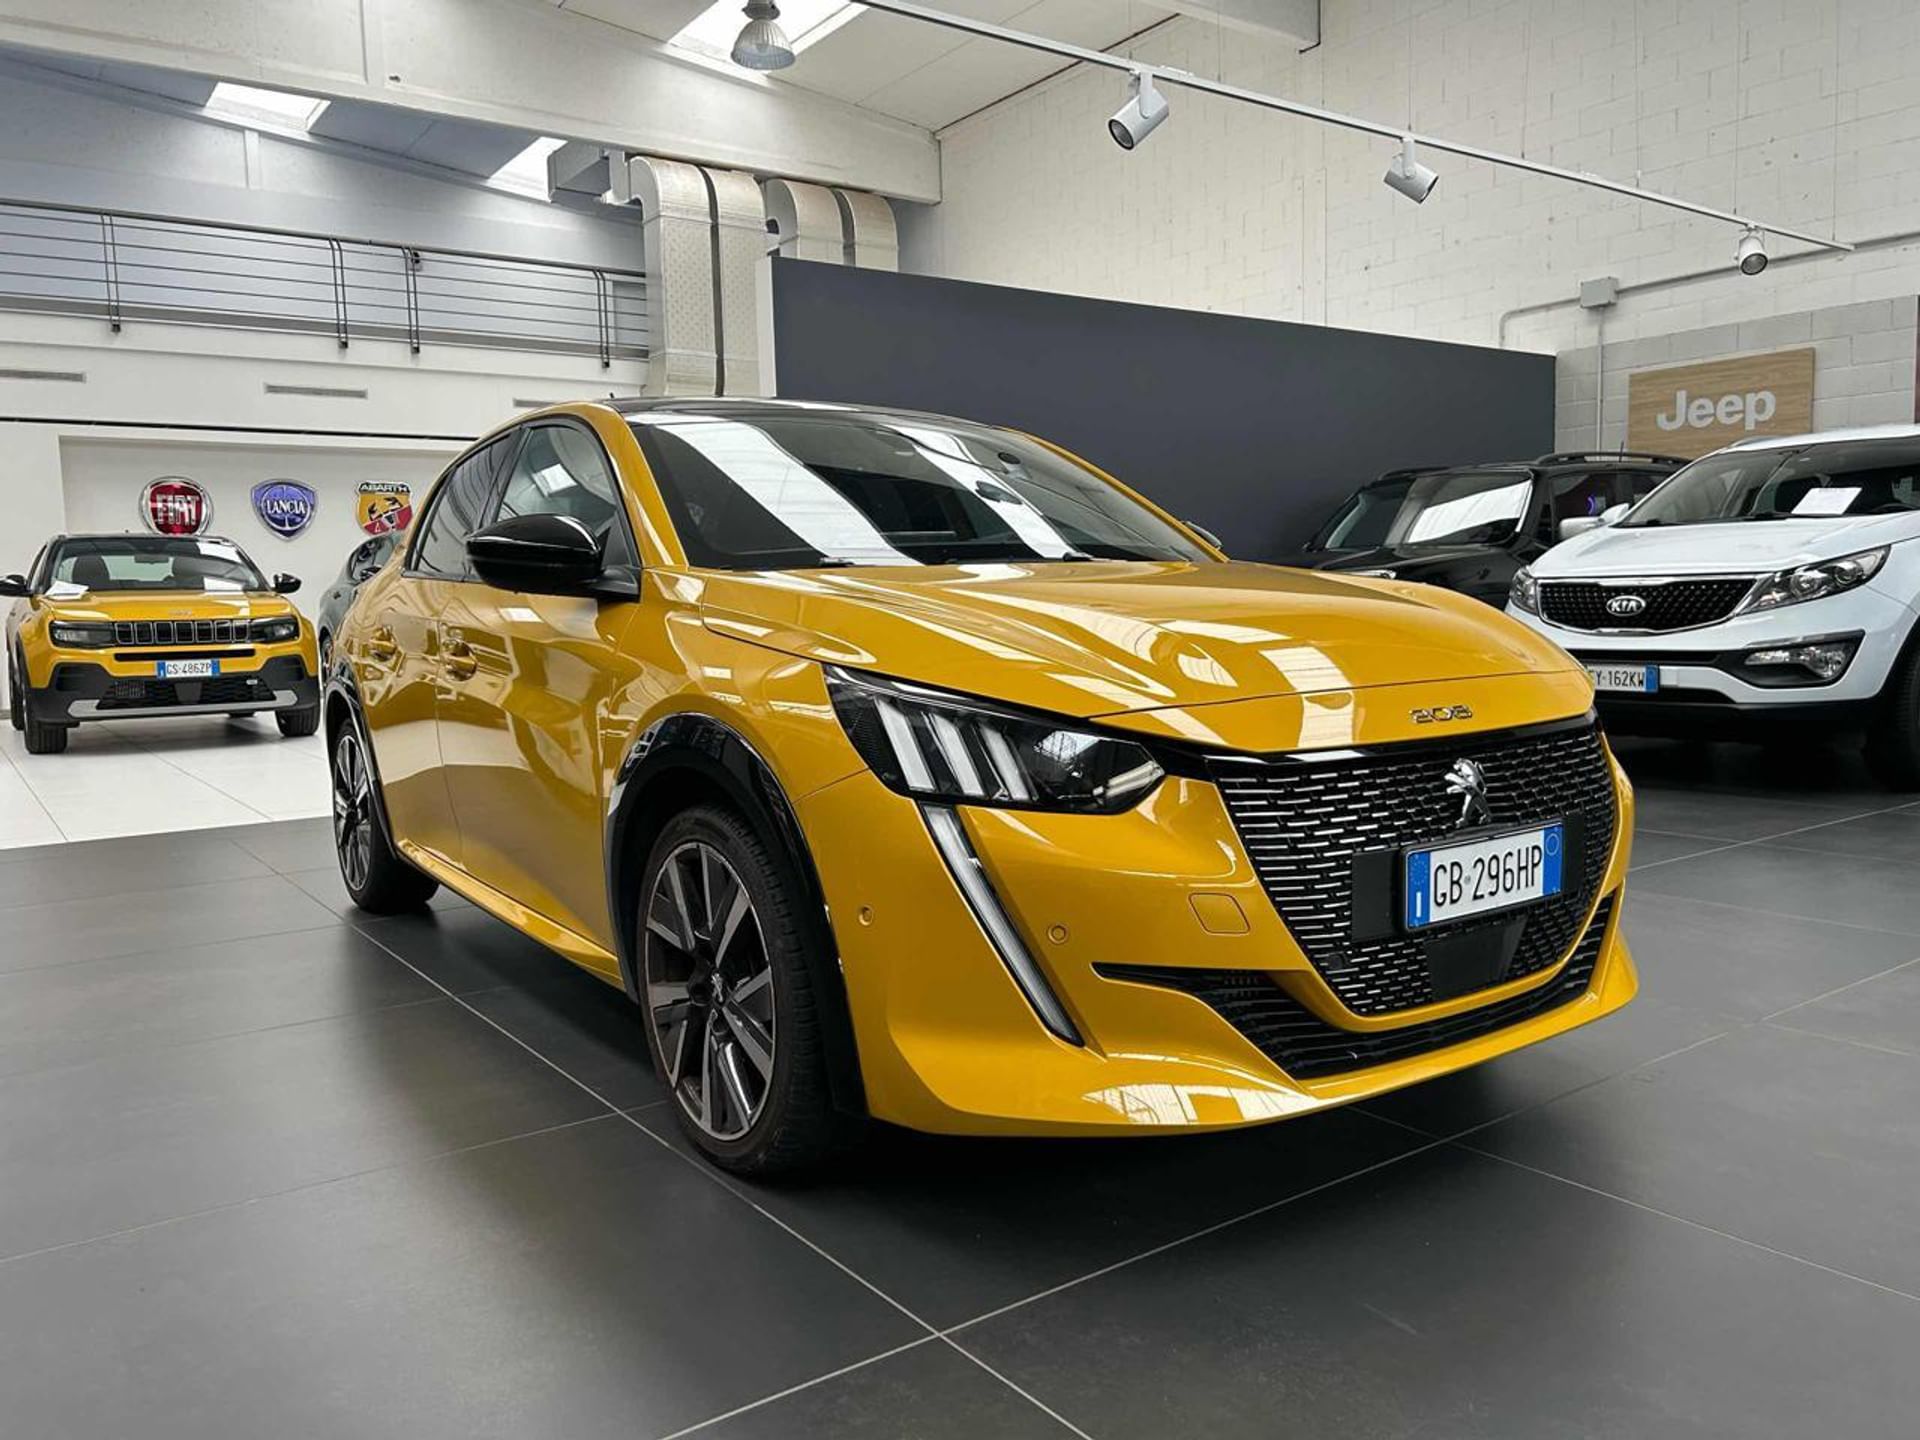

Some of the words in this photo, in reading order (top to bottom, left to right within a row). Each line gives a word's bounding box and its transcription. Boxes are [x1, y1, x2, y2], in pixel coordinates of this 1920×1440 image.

[1656, 389, 1776, 431] Jeep
[359, 483, 409, 492] ABARTH
[156, 494, 199, 525] FIAT
[266, 499, 305, 514] LANCIA
[1611, 600, 1637, 611] KIA
[1408, 704, 1473, 724] 208
